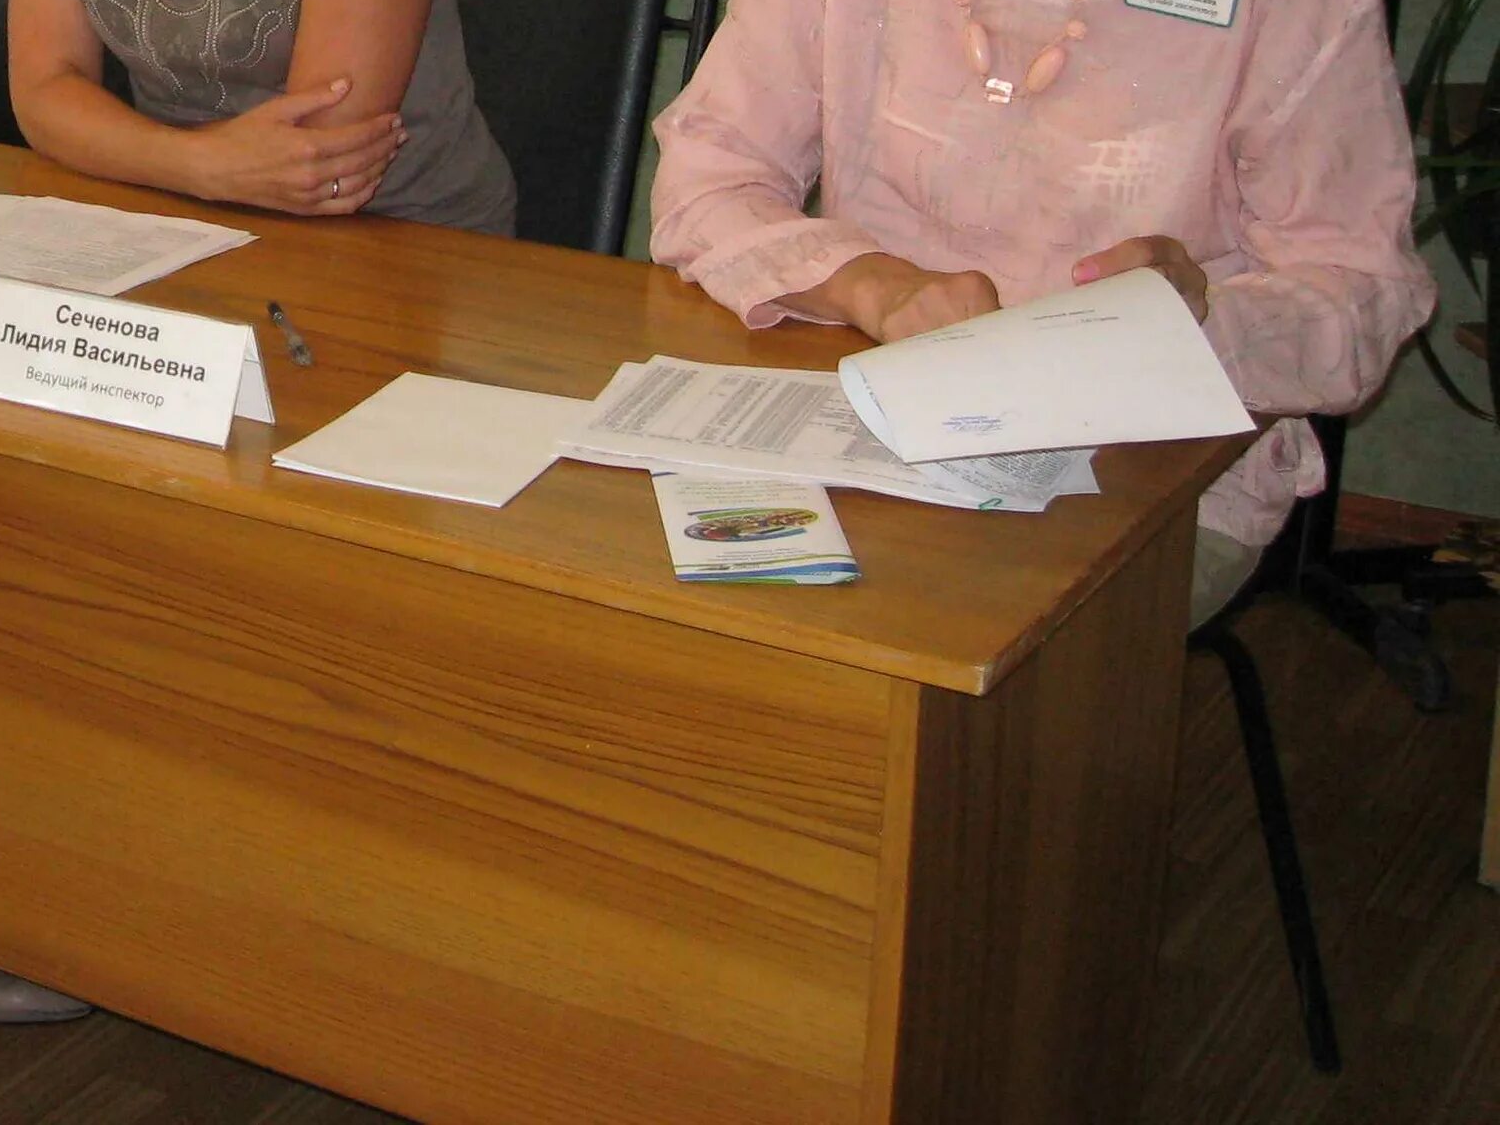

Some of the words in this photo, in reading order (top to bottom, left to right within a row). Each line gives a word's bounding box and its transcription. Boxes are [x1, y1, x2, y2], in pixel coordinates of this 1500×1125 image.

[56, 304, 161, 342] Сеченова
[0, 323, 66, 354] Лидия
[72, 338, 206, 382] Васильевна
[26, 365, 88, 392] Ведущий
[91, 382, 165, 409] инспектор
